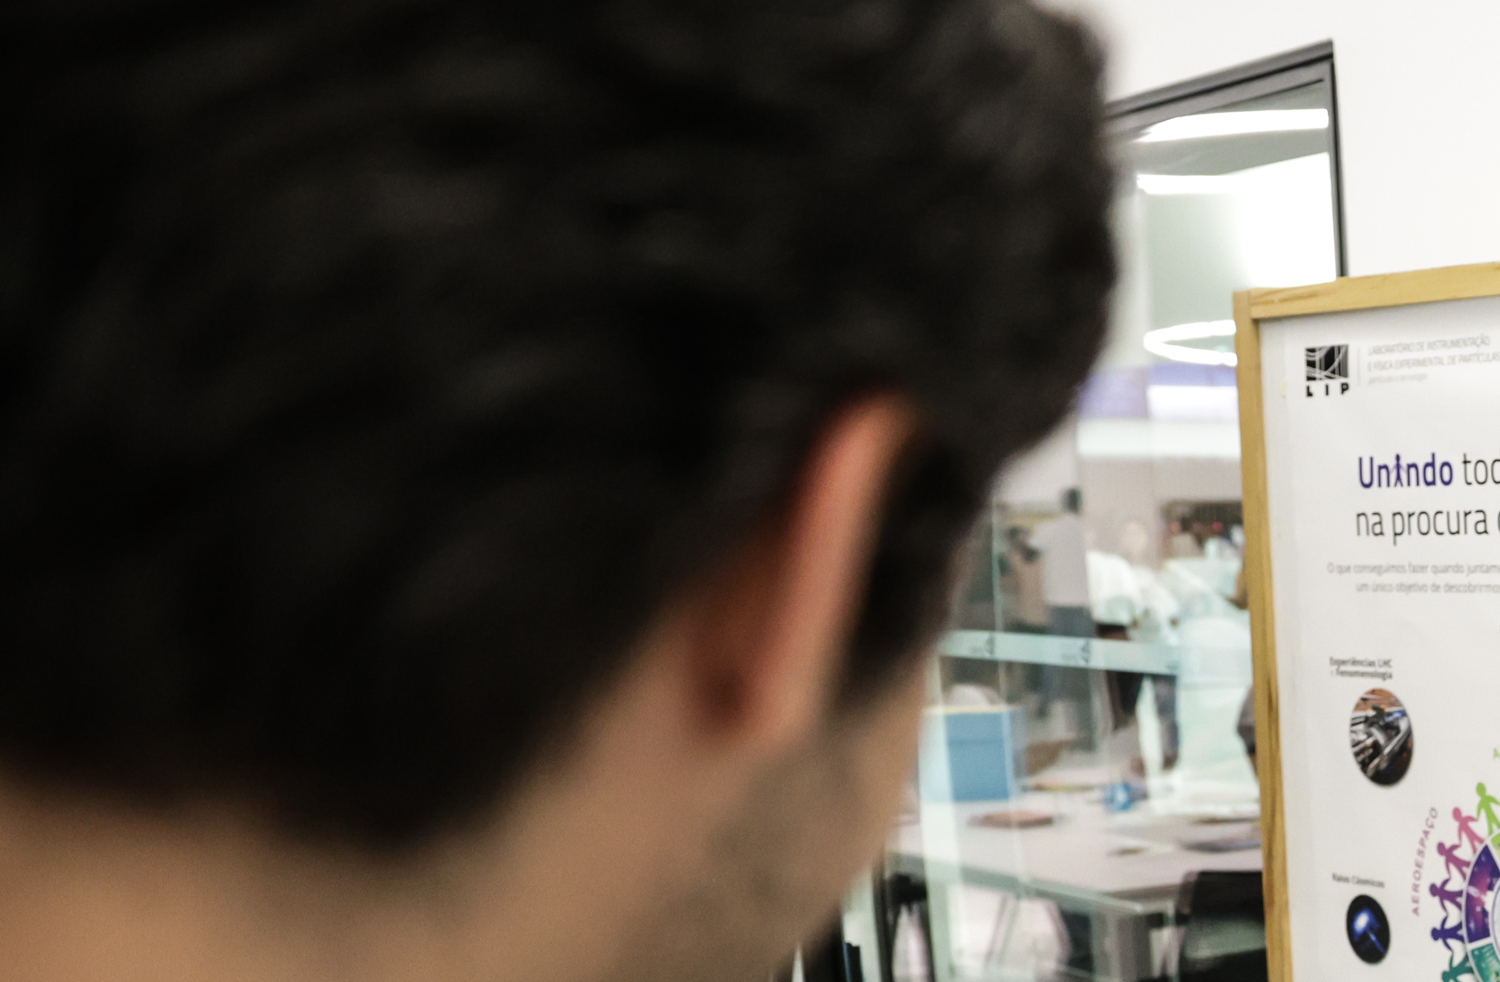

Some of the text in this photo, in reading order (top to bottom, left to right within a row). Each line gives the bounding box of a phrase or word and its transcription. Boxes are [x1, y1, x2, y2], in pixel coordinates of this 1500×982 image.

[1306, 383, 1349, 397] LIP
[1356, 510, 1384, 536] na
[1392, 509, 1489, 546] procura
[1412, 806, 1439, 917] AEROESPAÇO
